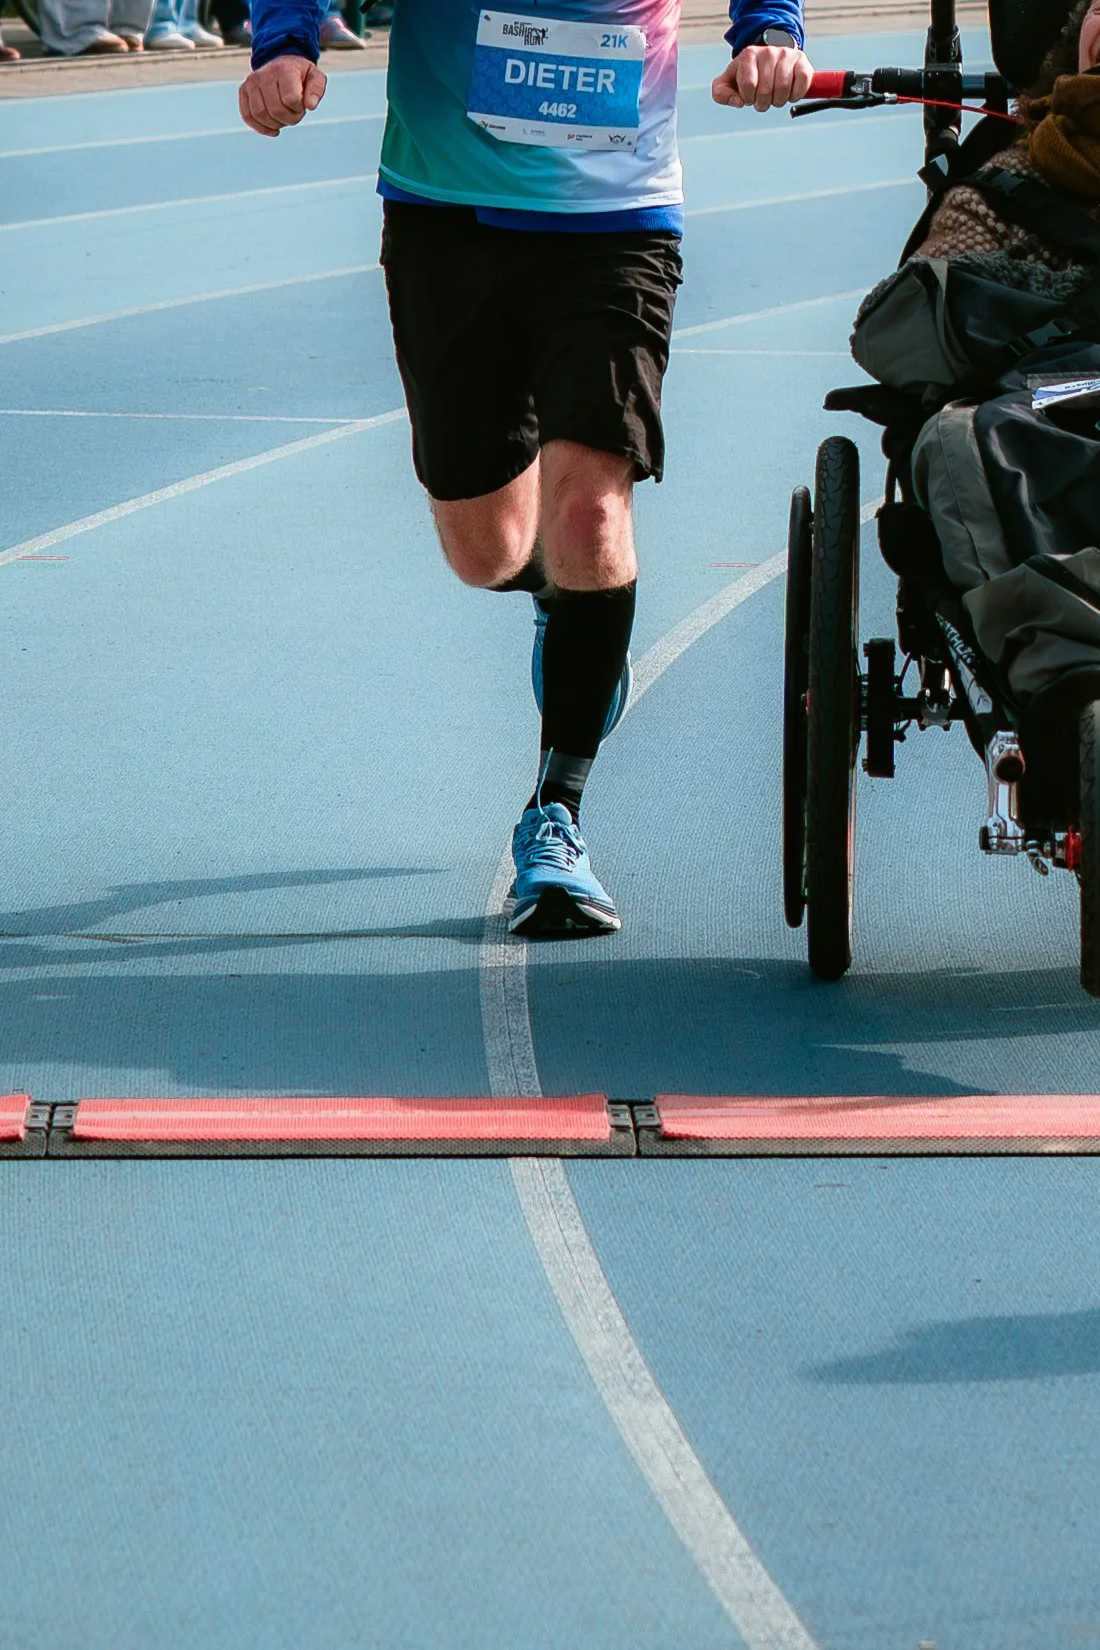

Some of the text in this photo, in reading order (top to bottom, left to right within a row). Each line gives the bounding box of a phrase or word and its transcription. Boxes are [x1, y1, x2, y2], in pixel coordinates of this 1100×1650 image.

[600, 33, 629, 49] 21K
[504, 58, 617, 94] DIETER
[538, 101, 578, 119] 4462
